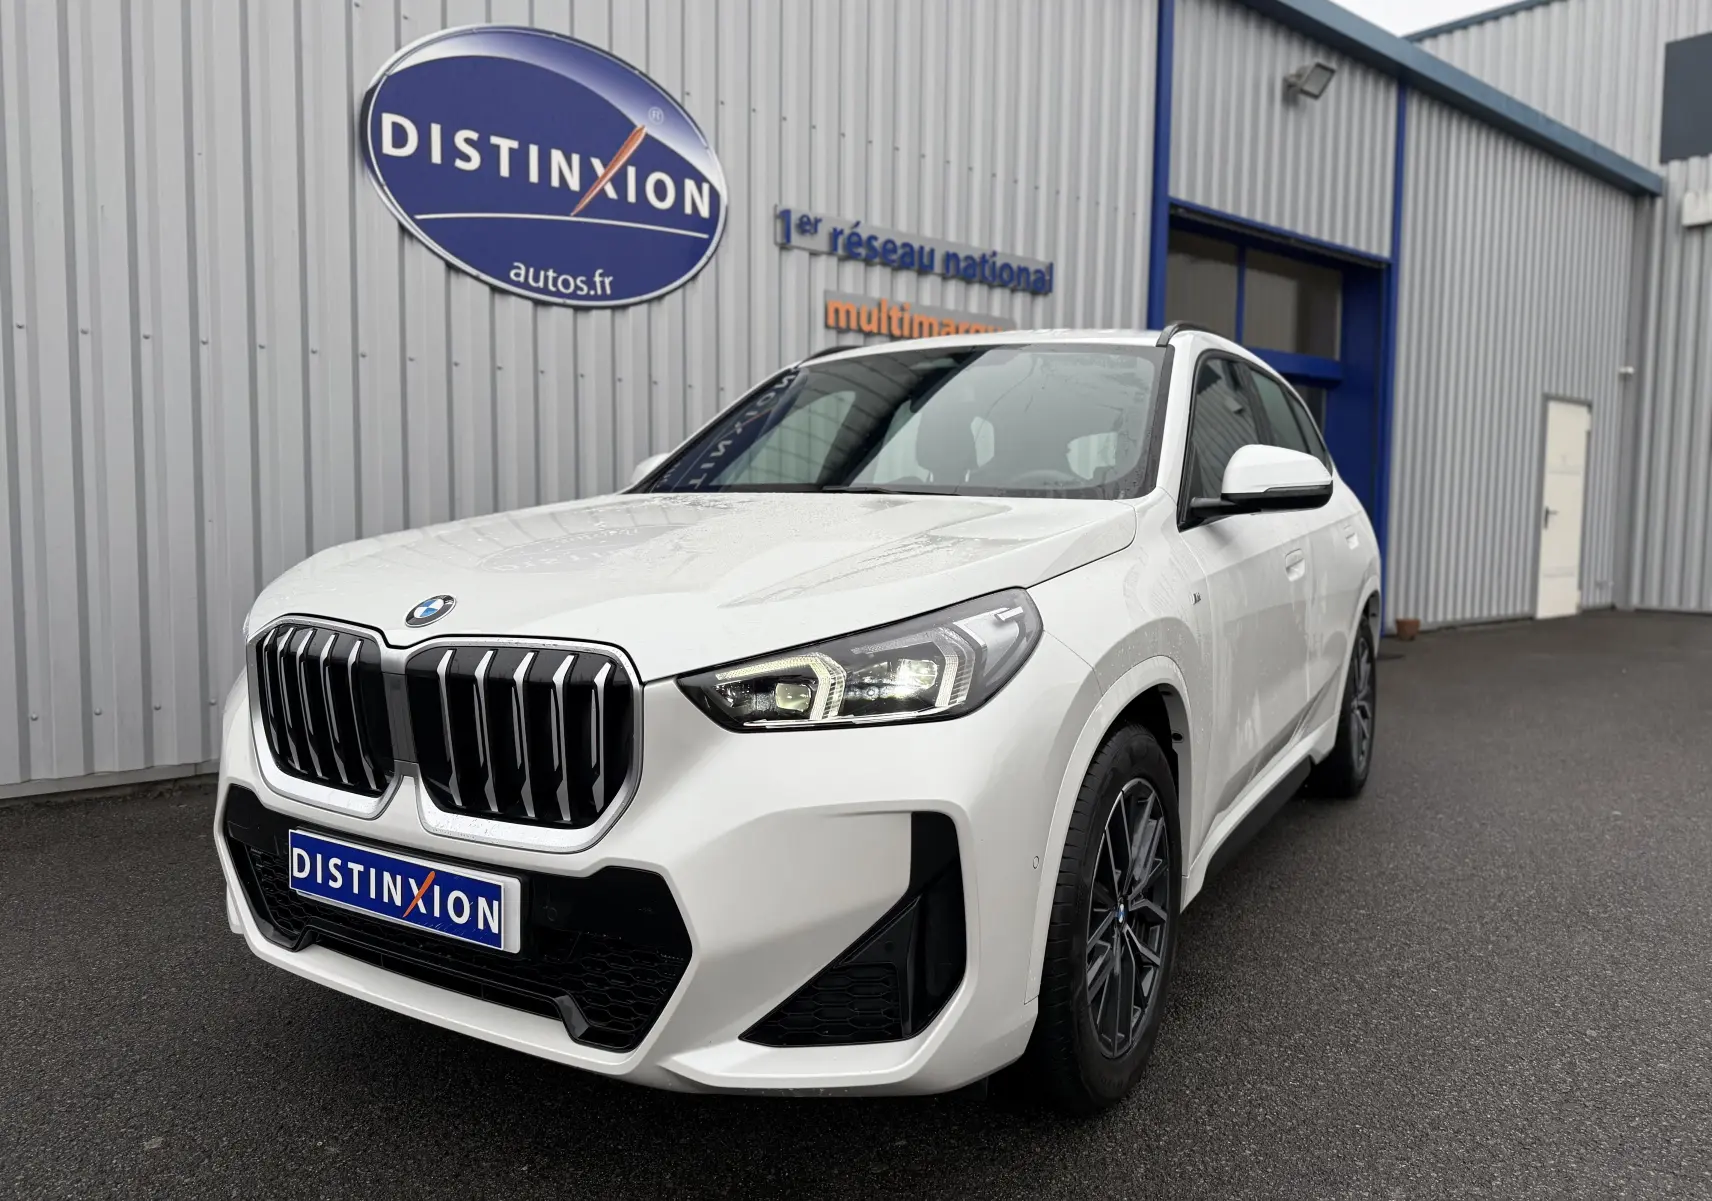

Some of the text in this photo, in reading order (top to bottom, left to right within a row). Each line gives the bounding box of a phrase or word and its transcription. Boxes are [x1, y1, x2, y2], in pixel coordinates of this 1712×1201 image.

[380, 112, 711, 219] DISTINXION
[509, 261, 614, 295] autos.fr
[778, 208, 1054, 294] 1er réseau national
[292, 846, 500, 935] DISTINXION
